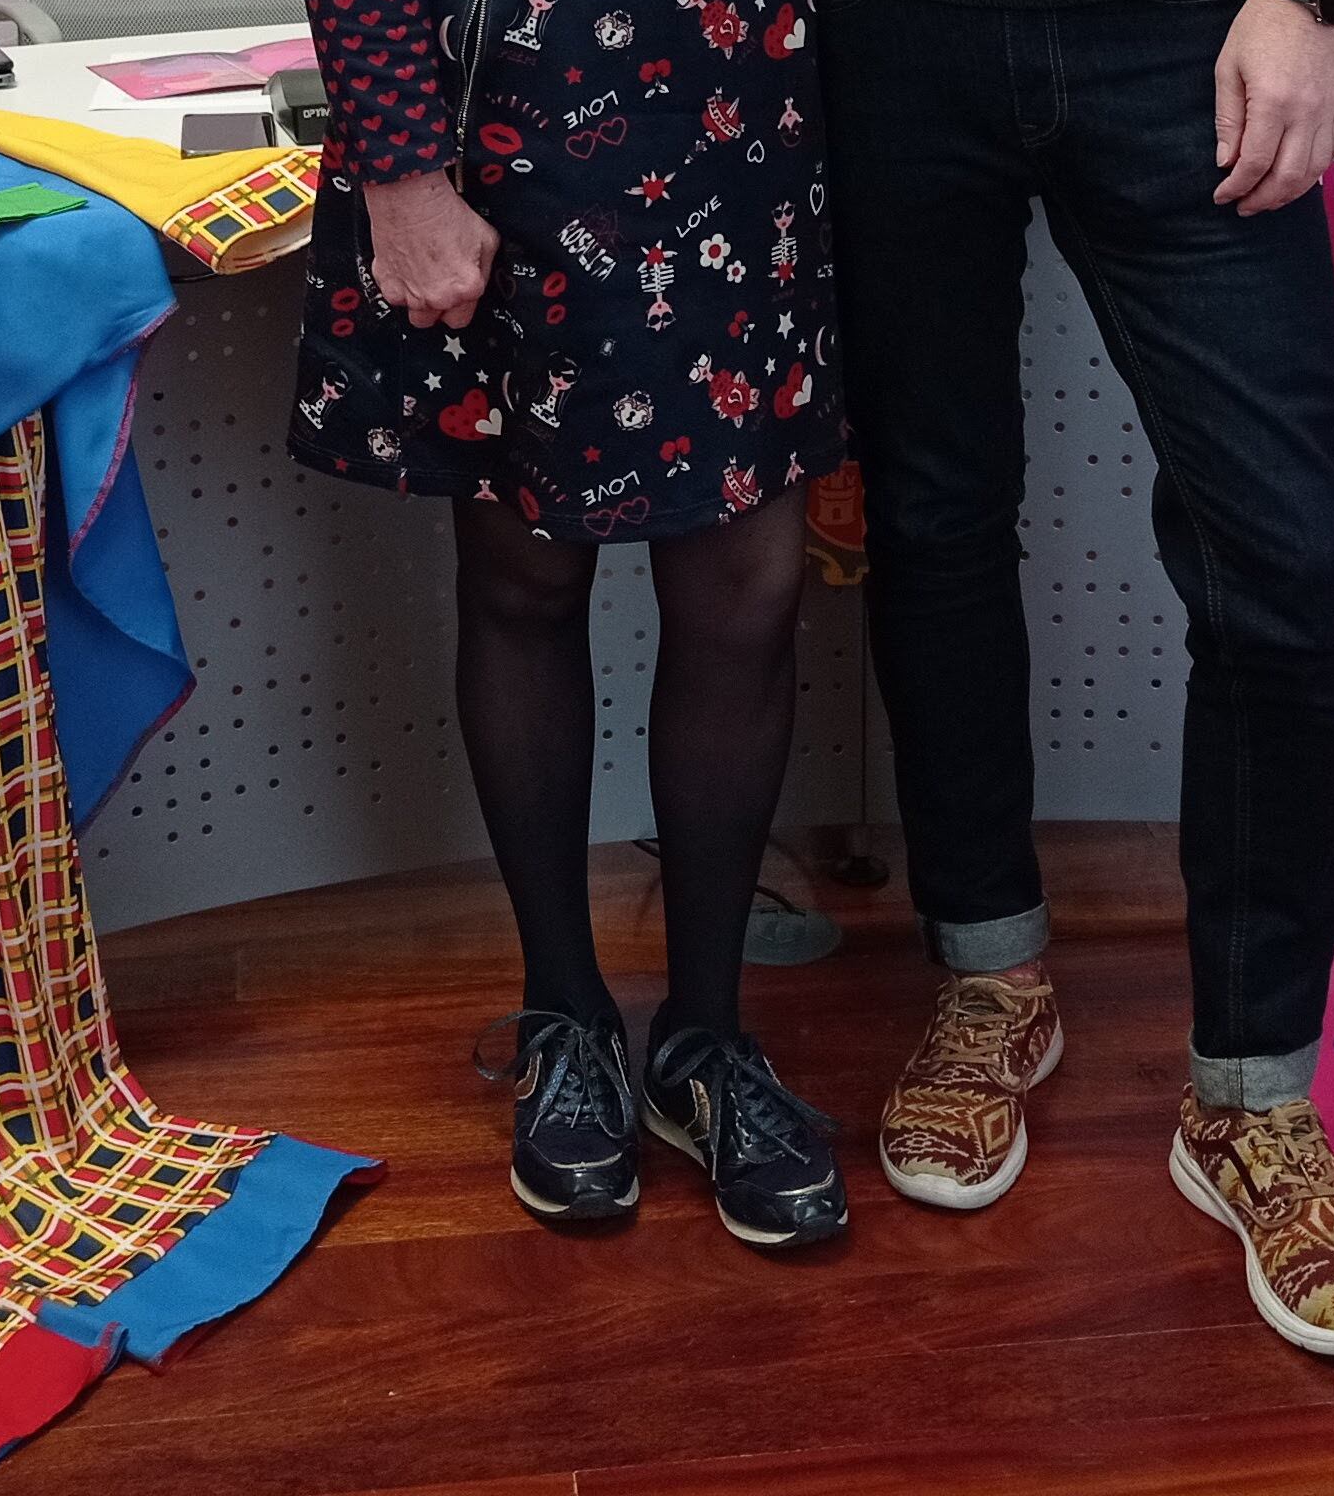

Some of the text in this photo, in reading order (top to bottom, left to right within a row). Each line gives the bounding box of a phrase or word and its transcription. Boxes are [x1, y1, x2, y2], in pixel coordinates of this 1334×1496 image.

[563, 90, 619, 130] LOVE
[675, 194, 722, 239] LOVE
[580, 470, 641, 507] LOVE
